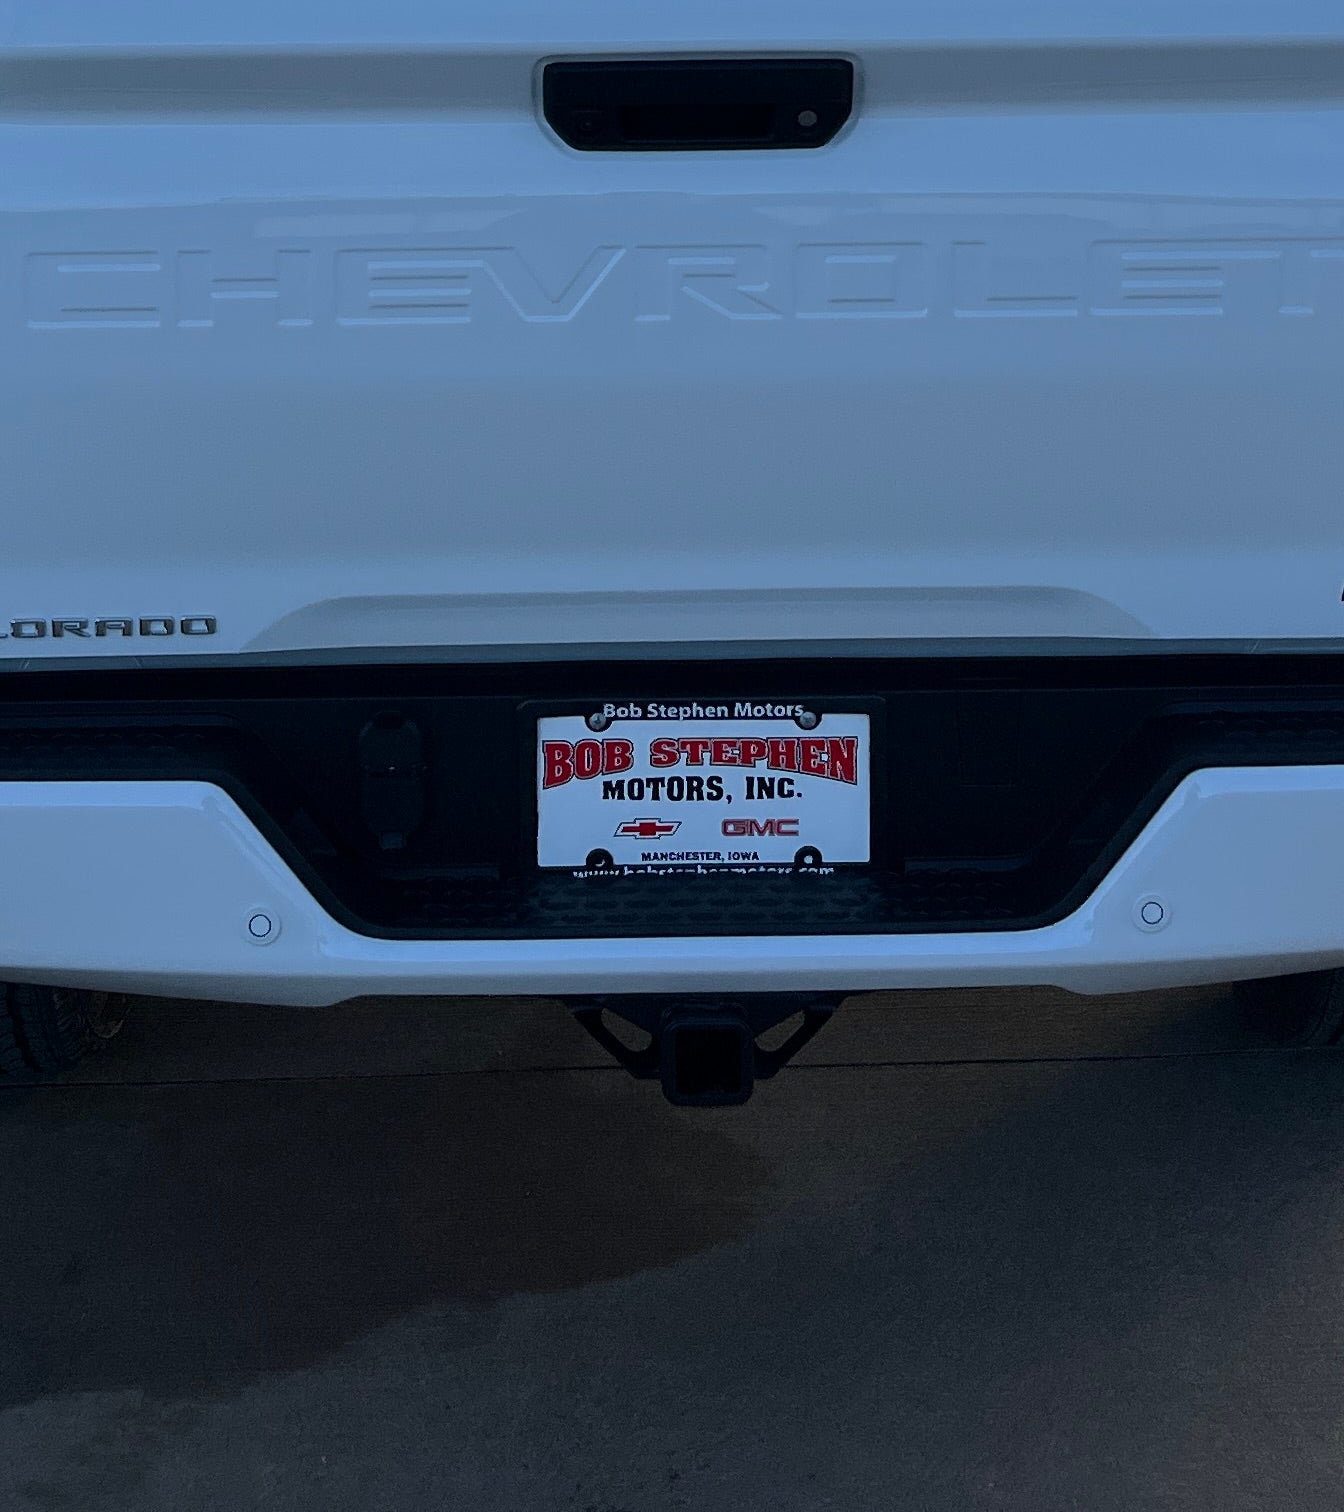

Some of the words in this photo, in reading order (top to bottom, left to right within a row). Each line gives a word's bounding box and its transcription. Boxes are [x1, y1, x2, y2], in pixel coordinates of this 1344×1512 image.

[603, 702, 642, 718] Bob
[647, 702, 729, 721] Stephen
[734, 701, 805, 718] Motors
[542, 738, 635, 791] BOB
[649, 736, 859, 786] STEPHEN
[602, 776, 733, 805] MOTORS,
[745, 776, 803, 800] INC.
[721, 818, 800, 837] GMC
[641, 851, 725, 863] MANCHESTER,
[727, 851, 760, 861] IOWA
